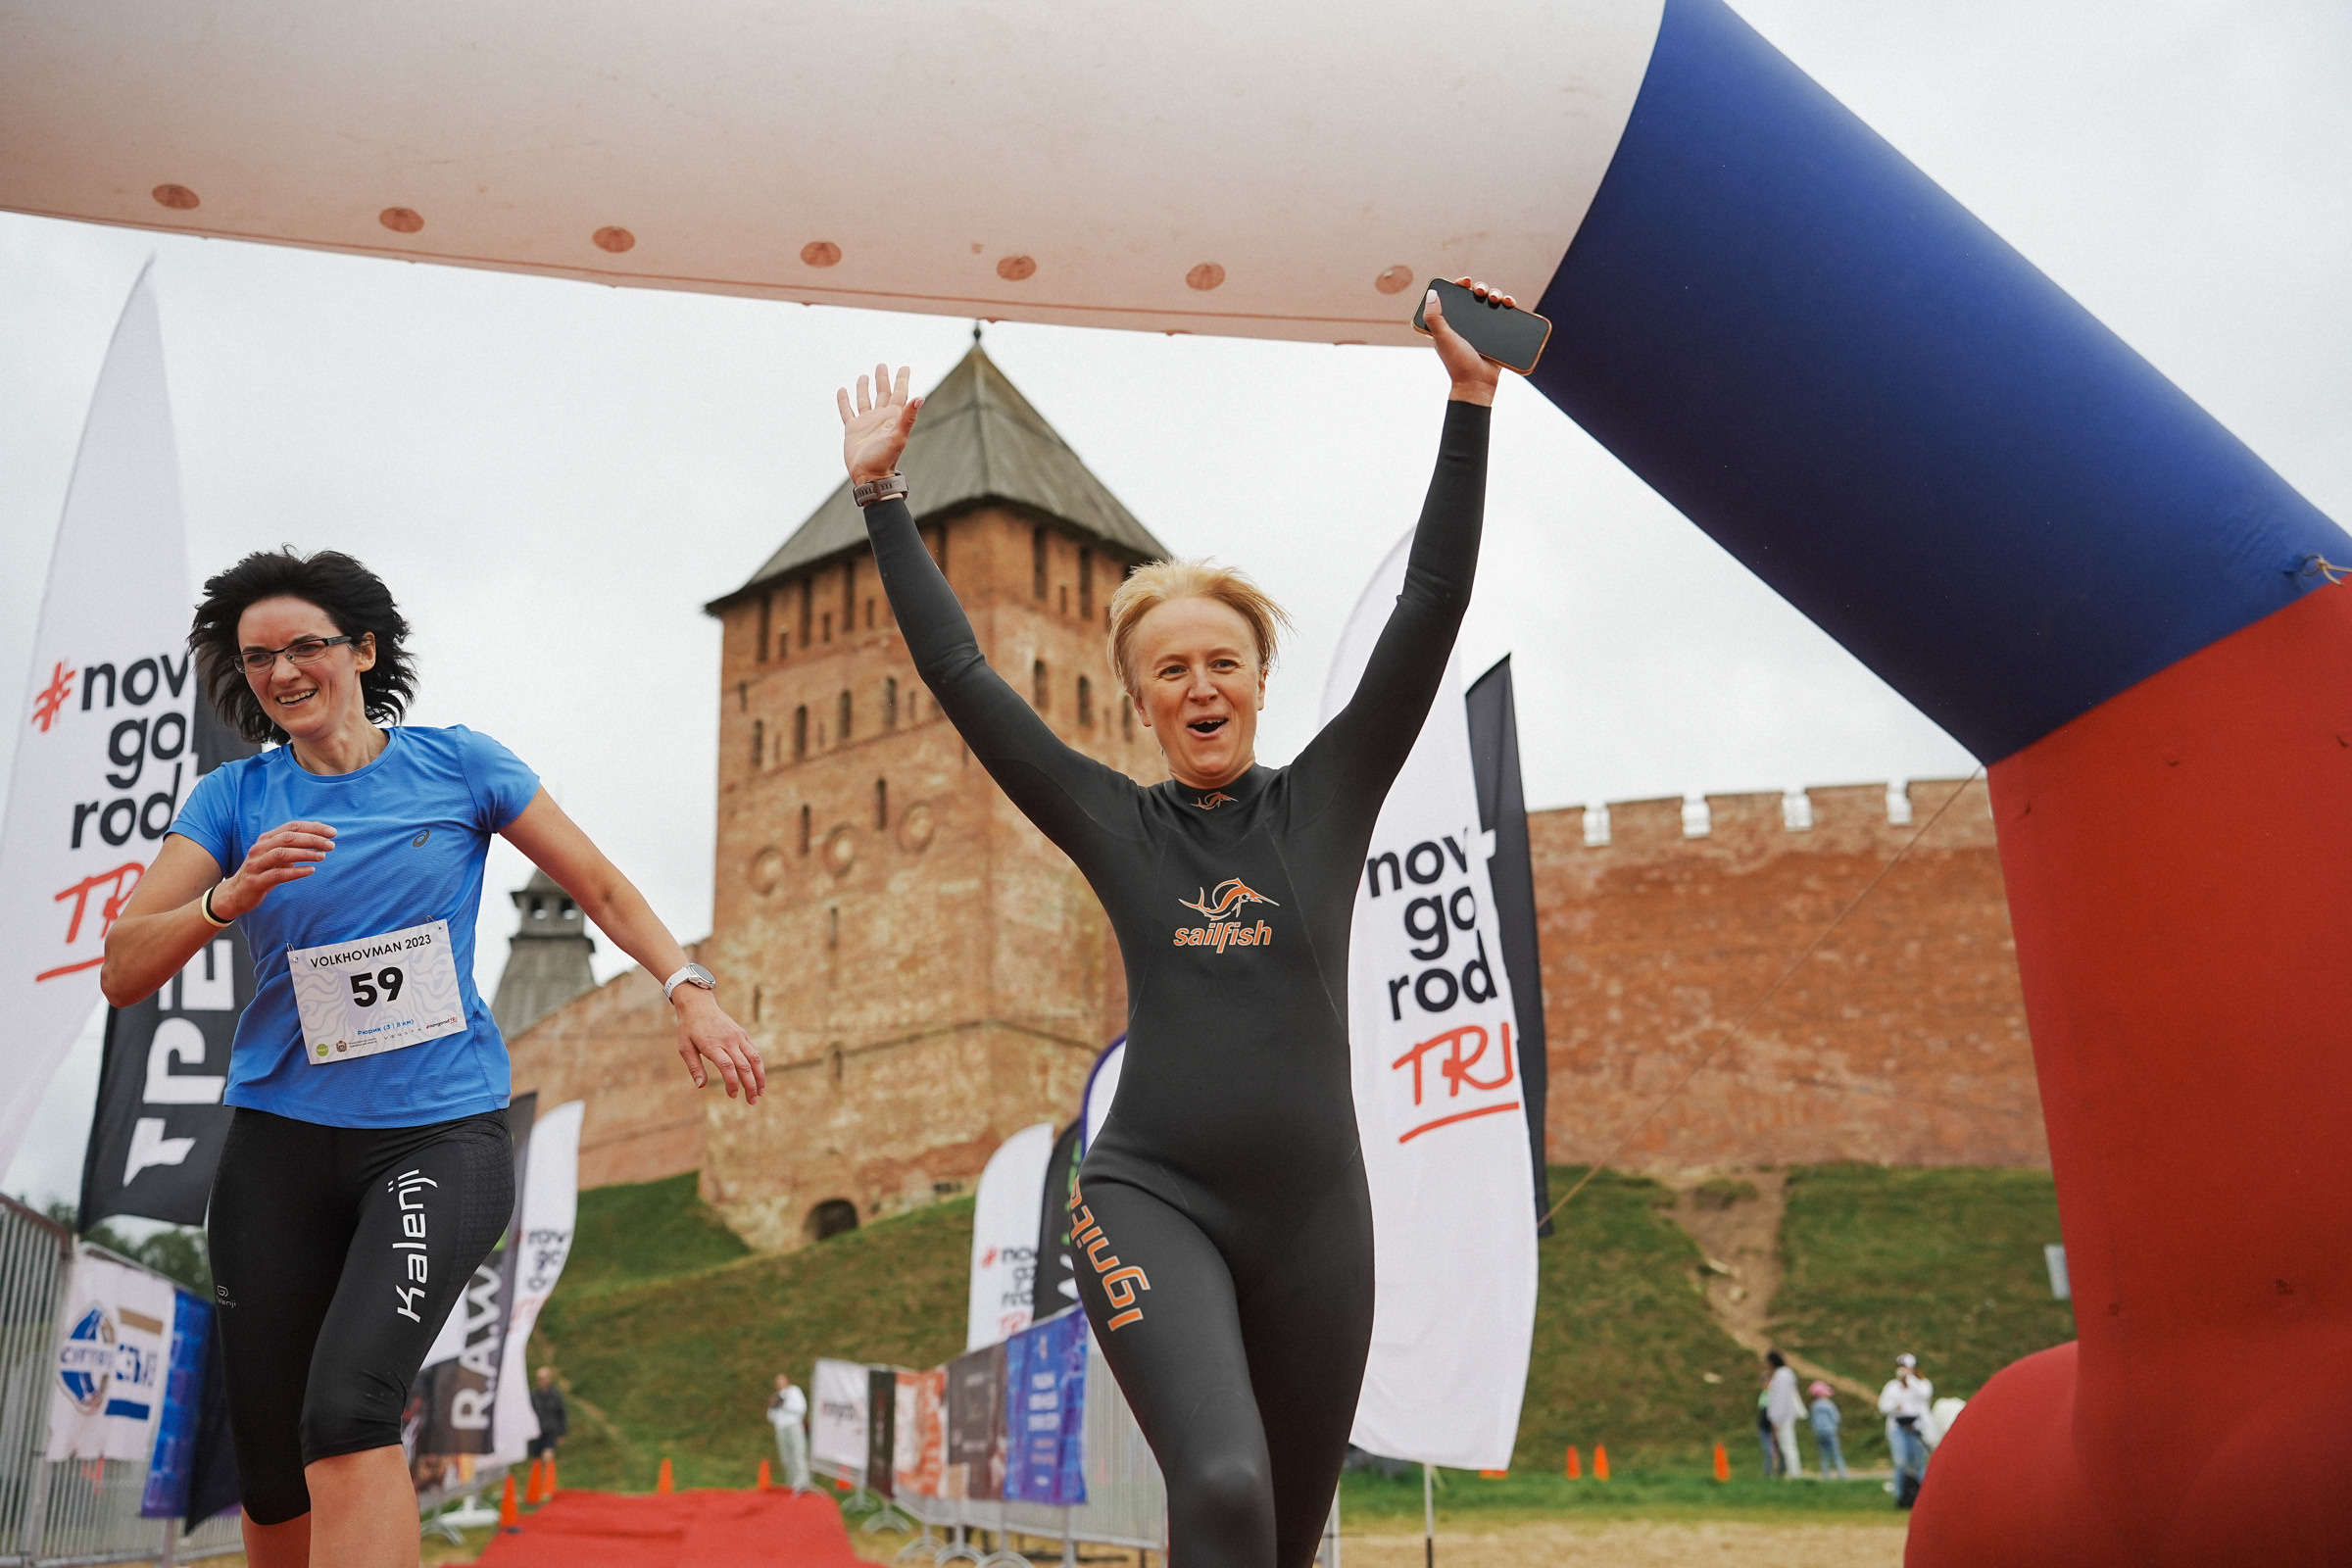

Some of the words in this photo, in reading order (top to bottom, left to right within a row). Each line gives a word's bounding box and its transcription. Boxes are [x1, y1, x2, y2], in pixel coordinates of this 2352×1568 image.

[106, 711, 186, 789] go
[71, 762, 182, 849] rod
[311, 942, 402, 968] VOLKHOVMAN
[405, 934, 432, 951] 2023
[1173, 920, 1272, 954] sailfish
[1404, 886, 1475, 960] go
[350, 966, 404, 1007] 59
[1388, 930, 1497, 1021] rod
[1393, 1021, 1514, 1105] TRI
